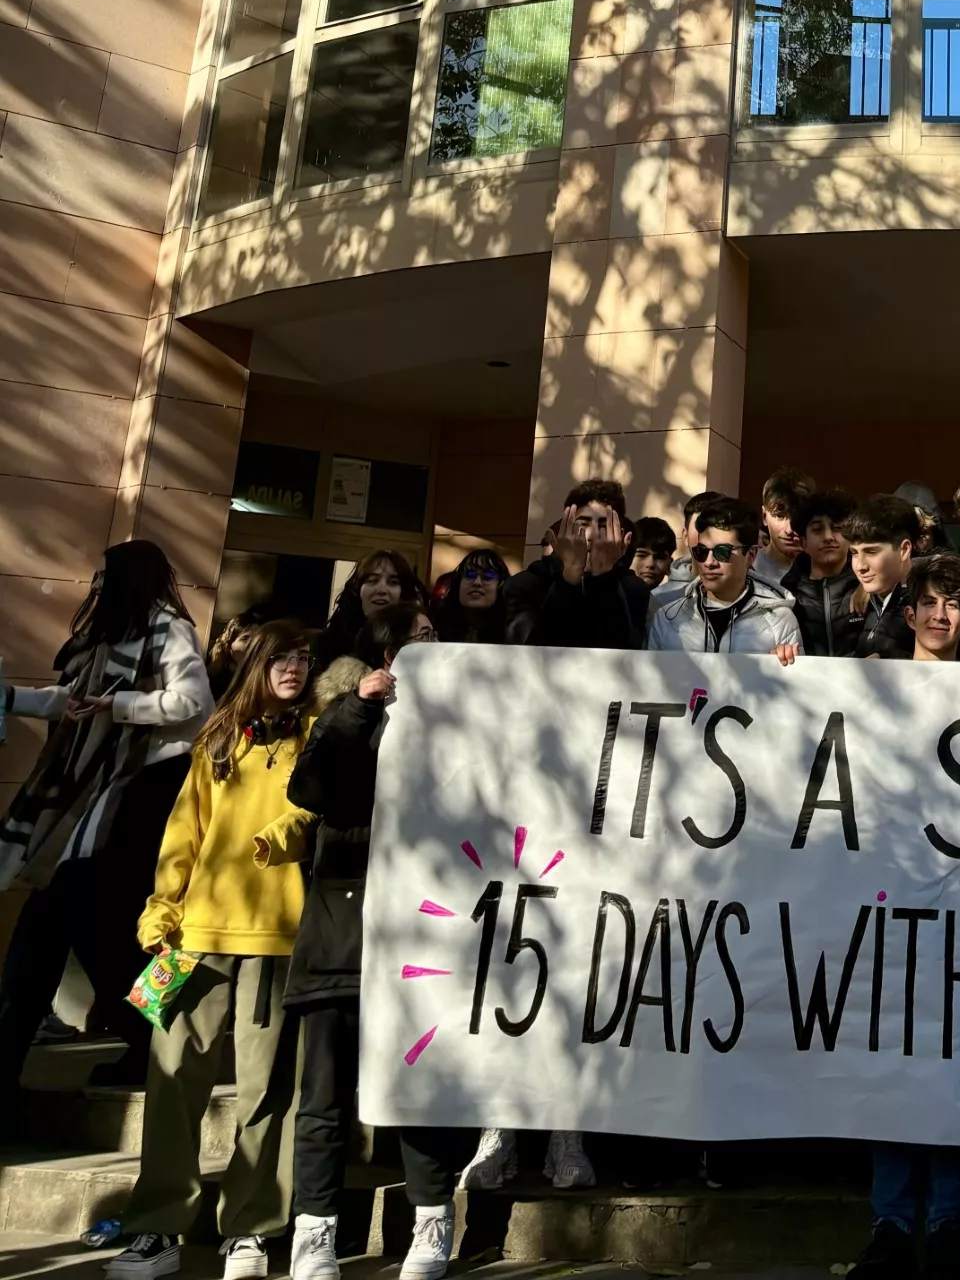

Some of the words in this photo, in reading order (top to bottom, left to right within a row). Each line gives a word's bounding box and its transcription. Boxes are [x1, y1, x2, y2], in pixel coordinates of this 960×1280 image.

[590, 688, 754, 849] IT'S
[791, 711, 860, 852] A
[469, 880, 560, 1037] 15
[582, 890, 751, 1054] DAYS
